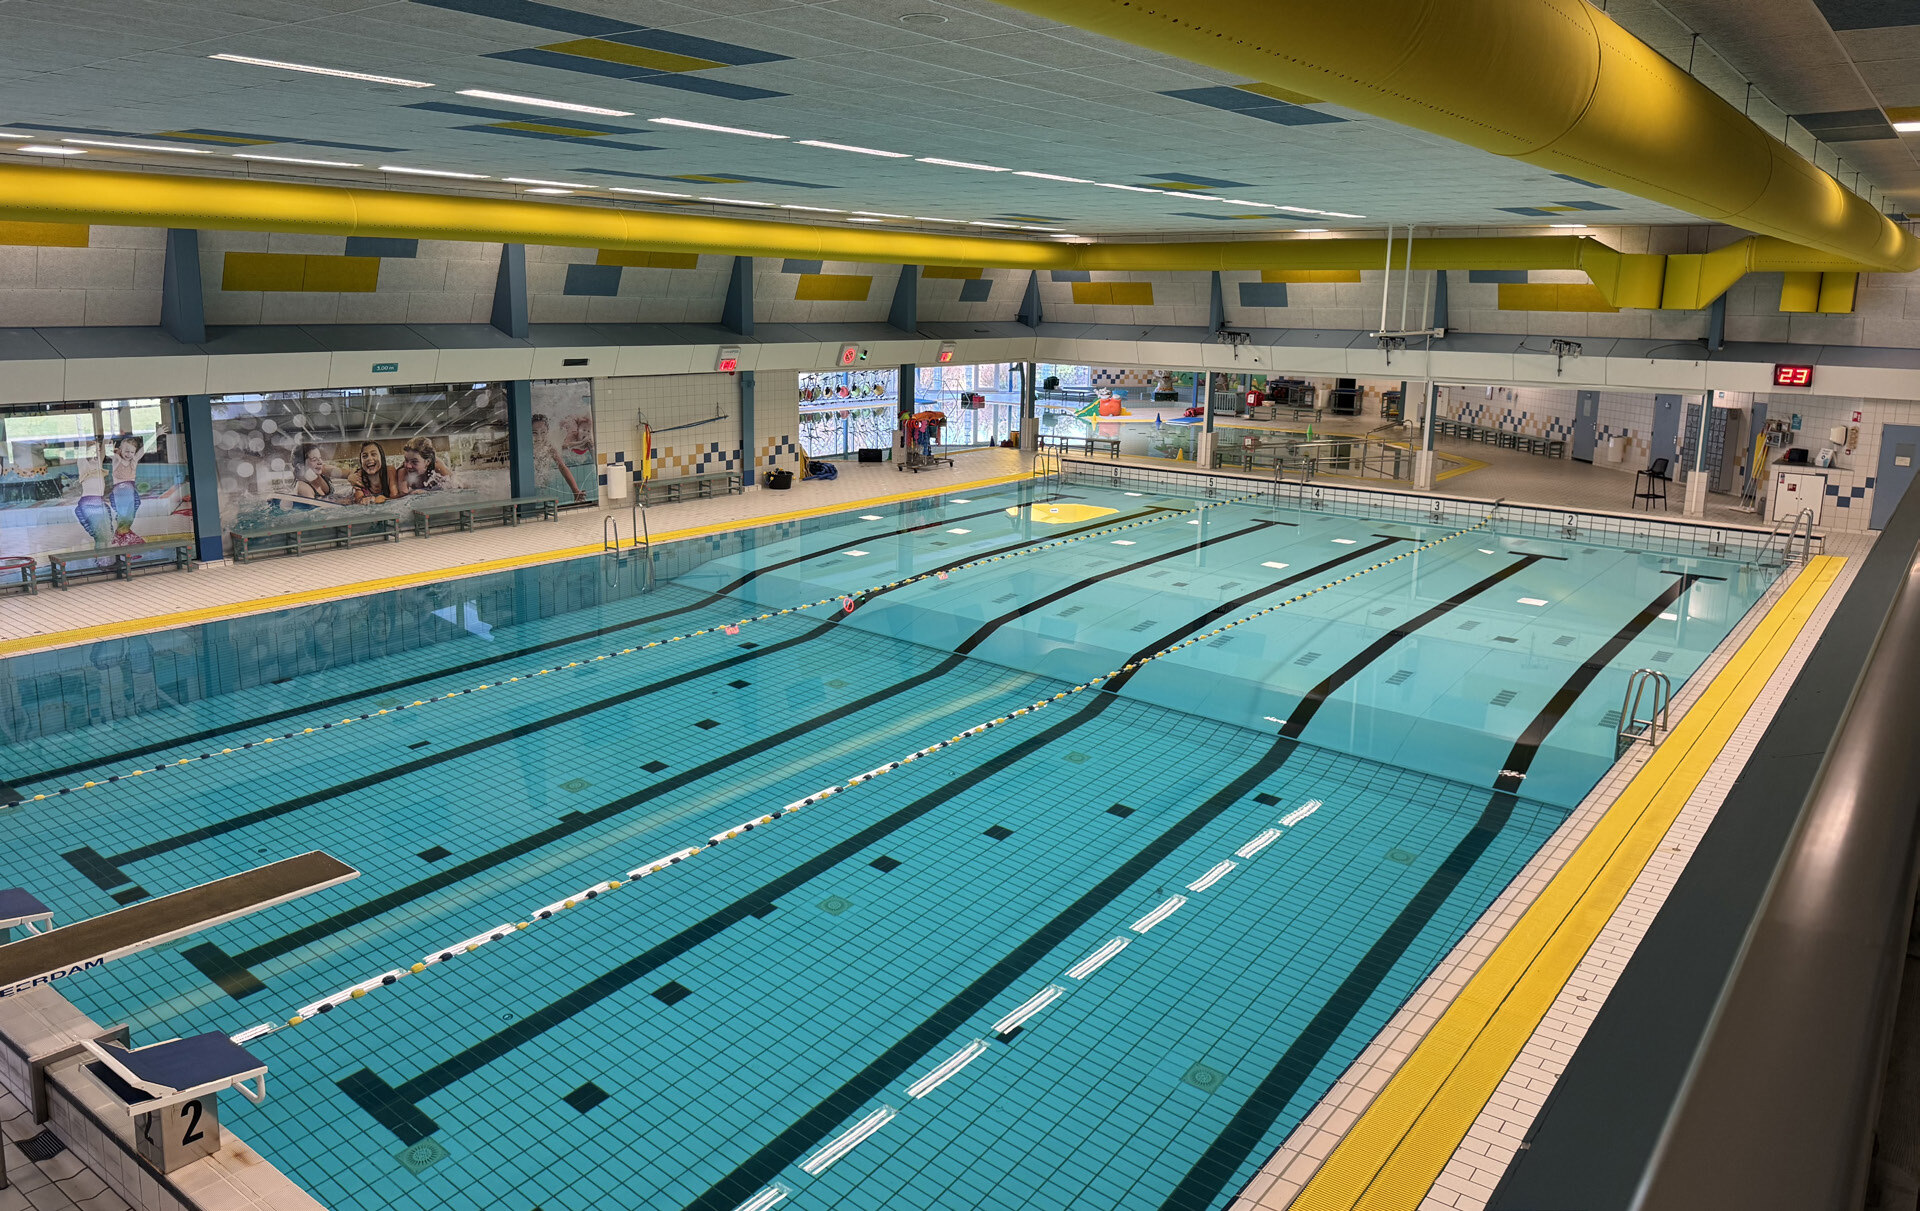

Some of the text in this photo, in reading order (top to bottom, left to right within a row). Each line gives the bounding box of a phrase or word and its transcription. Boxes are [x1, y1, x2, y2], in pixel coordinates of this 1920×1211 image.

[1779, 369, 1808, 384] 23
[1113, 467, 1119, 477] 6
[1209, 478, 1214, 487] 5
[1315, 488, 1320, 498] 4
[1434, 501, 1440, 511] 3
[1567, 515, 1574, 525] 2
[1716, 531, 1720, 542] 1
[181, 1100, 204, 1146] 2
